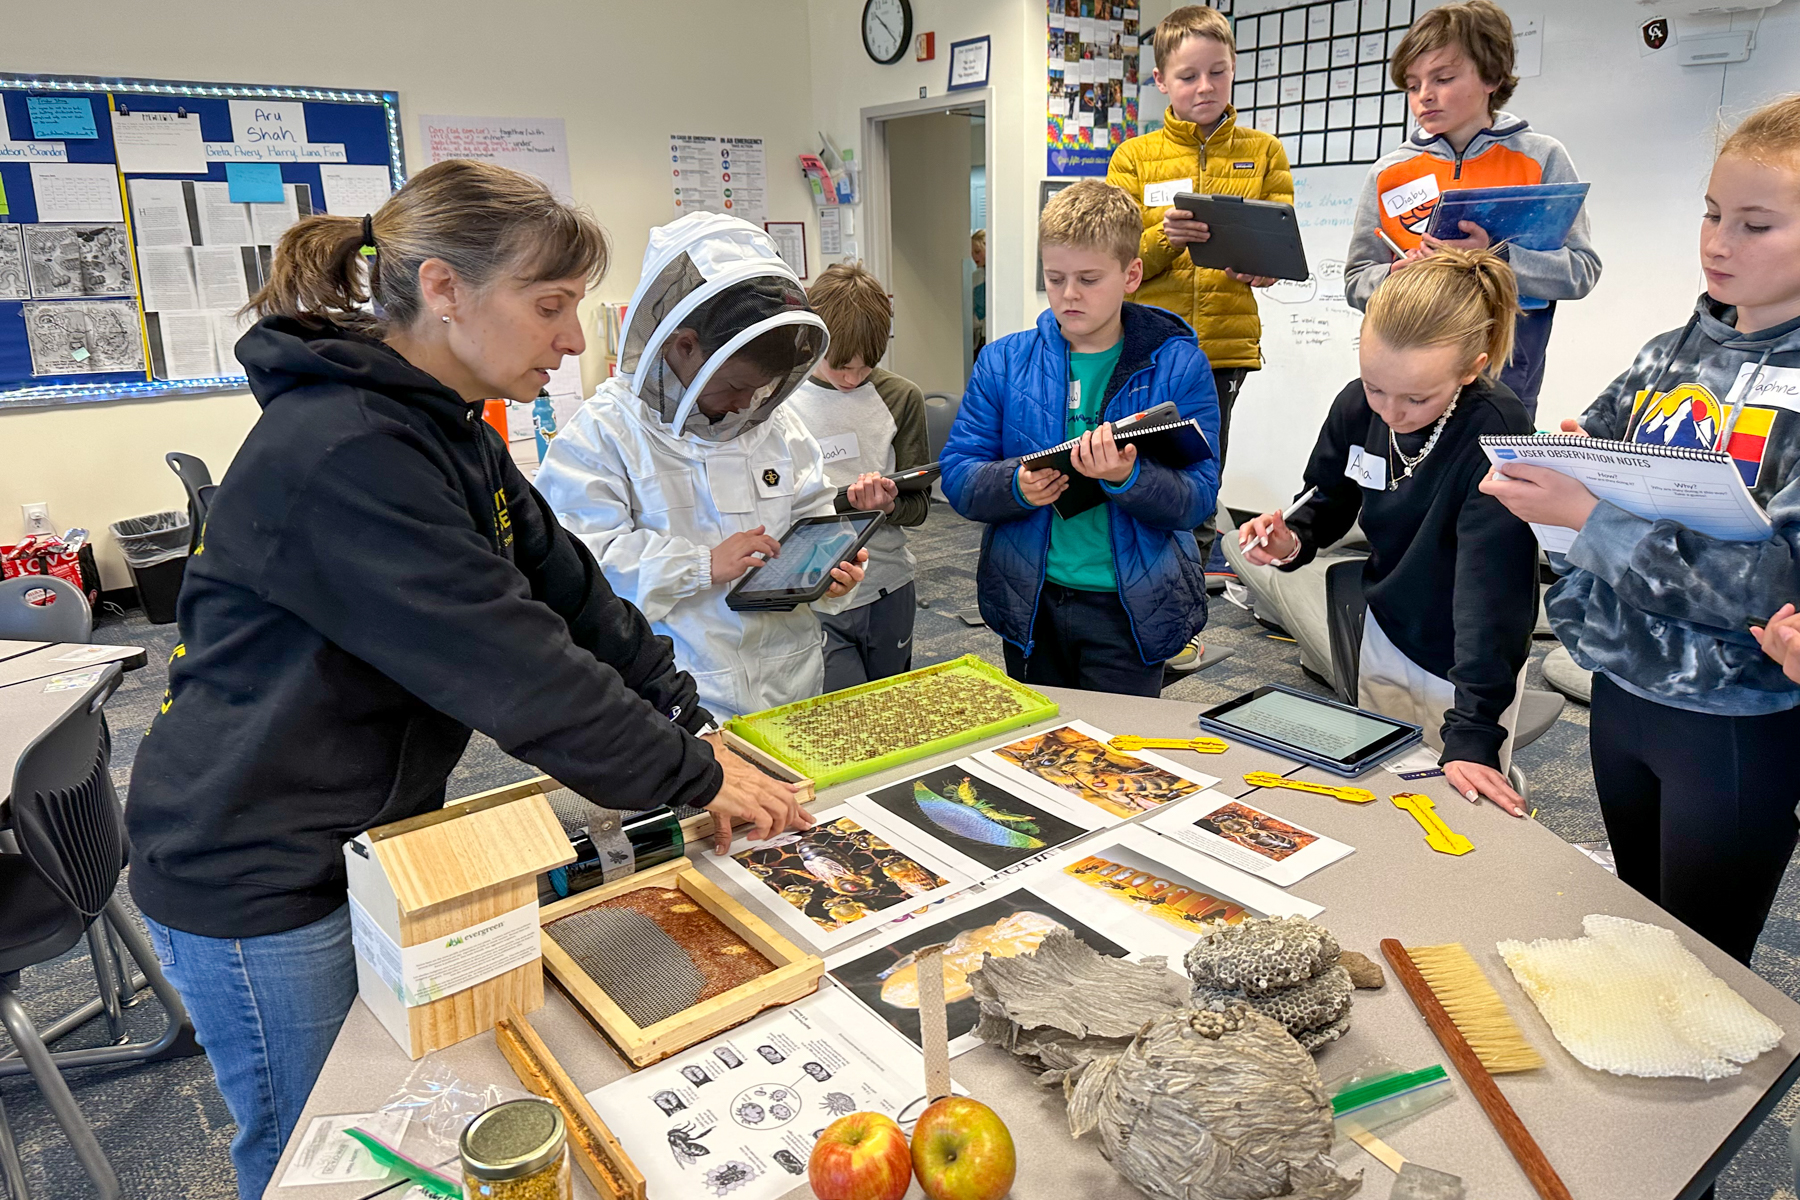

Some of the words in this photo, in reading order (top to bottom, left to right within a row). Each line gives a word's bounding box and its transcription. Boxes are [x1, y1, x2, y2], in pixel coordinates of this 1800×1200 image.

[255, 108, 282, 121] Aru
[247, 126, 297, 142] Shah
[27, 144, 66, 156] Brandon
[323, 145, 344, 157] Finn
[1150, 191, 1169, 202] Eli
[1387, 189, 1427, 210] Digby
[1518, 449, 1545, 458] USER
[1547, 449, 1615, 464] OBSERVATION
[1617, 456, 1651, 468] NOTES
[464, 922, 505, 941] evergreen
